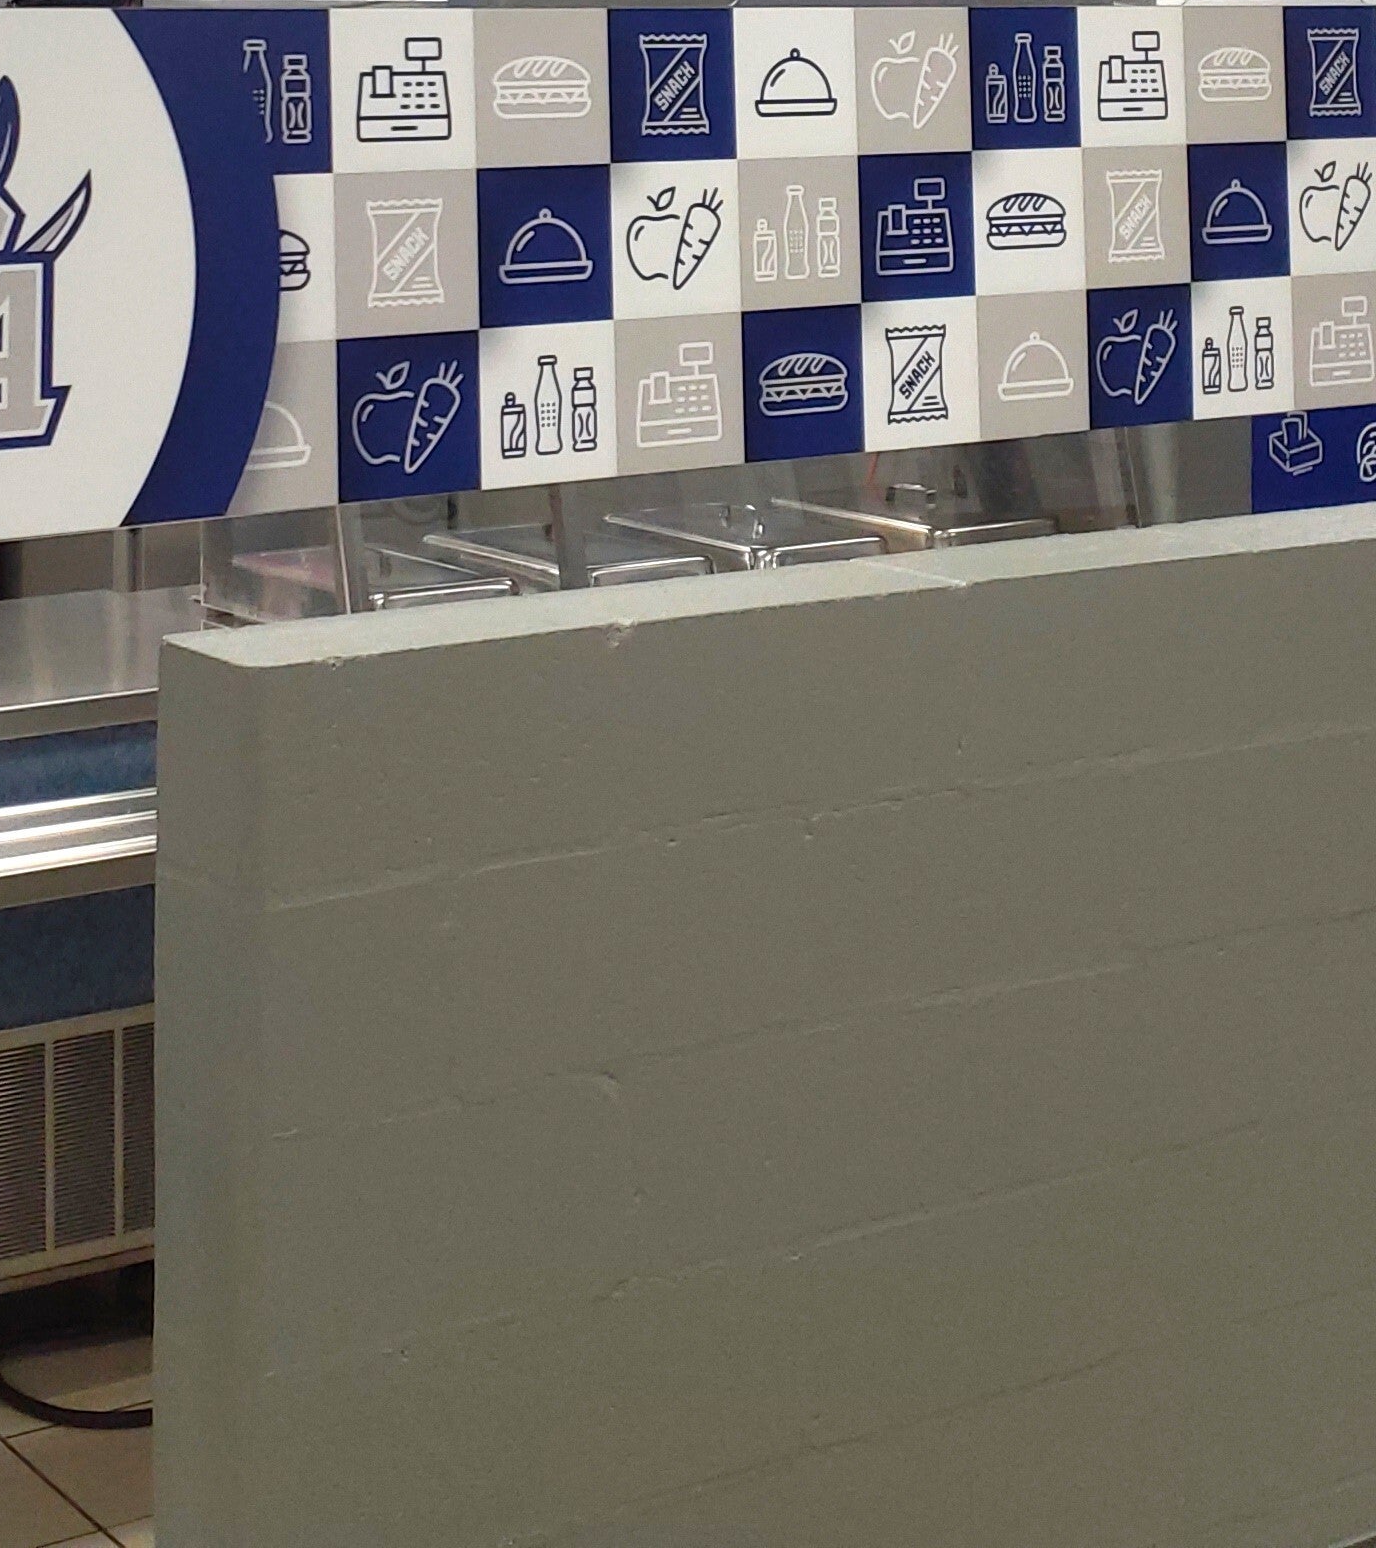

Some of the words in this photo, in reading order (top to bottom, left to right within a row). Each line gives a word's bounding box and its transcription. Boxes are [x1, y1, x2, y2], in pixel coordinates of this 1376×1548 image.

[654, 60, 696, 111] SNACK
[1318, 51, 1351, 96] SNACK
[383, 227, 430, 281] SNACK
[899, 350, 936, 400] SNACK
